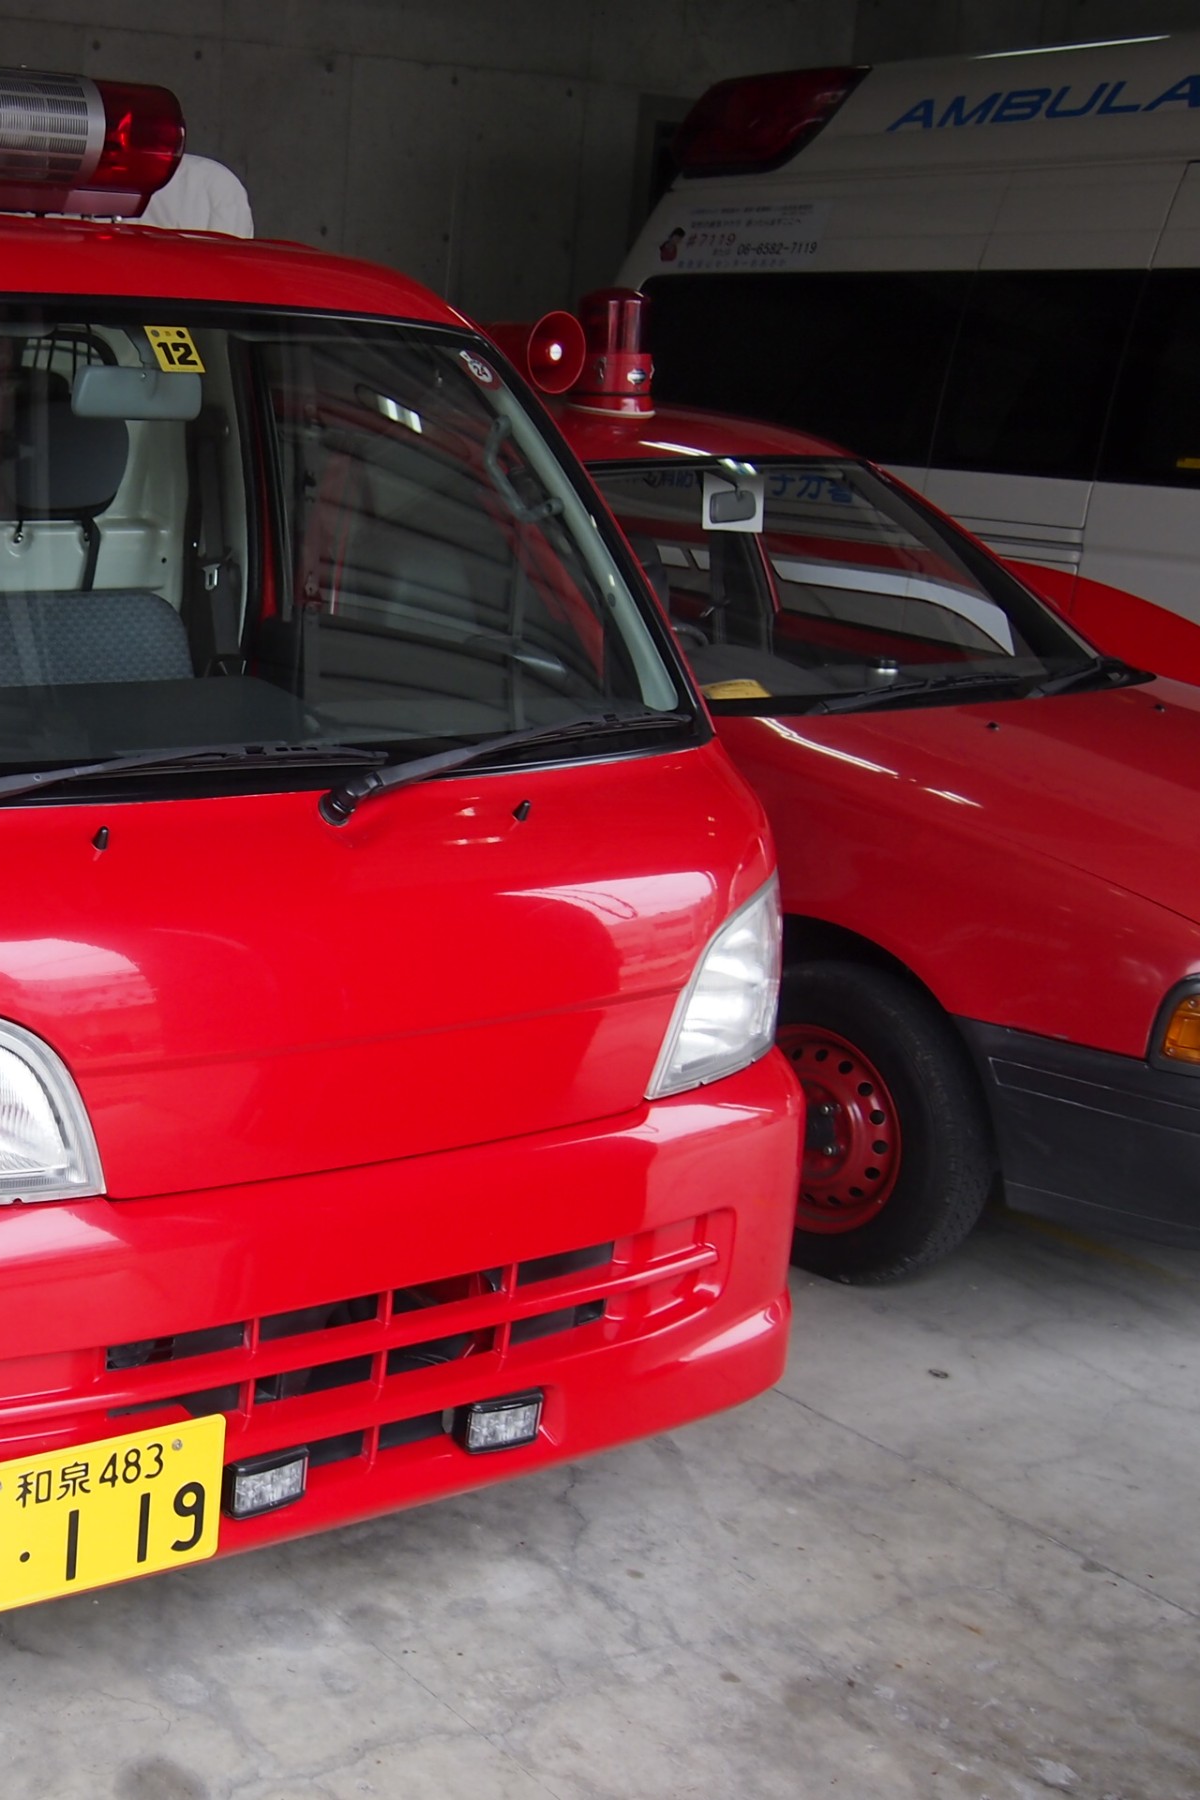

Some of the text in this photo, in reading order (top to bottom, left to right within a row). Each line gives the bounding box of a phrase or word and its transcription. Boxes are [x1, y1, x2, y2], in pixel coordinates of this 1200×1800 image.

[886, 75, 1200, 132] AMBULA
[686, 233, 736, 248] #7119
[737, 241, 818, 256] 06-6582-7119
[156, 342, 198, 365] 12
